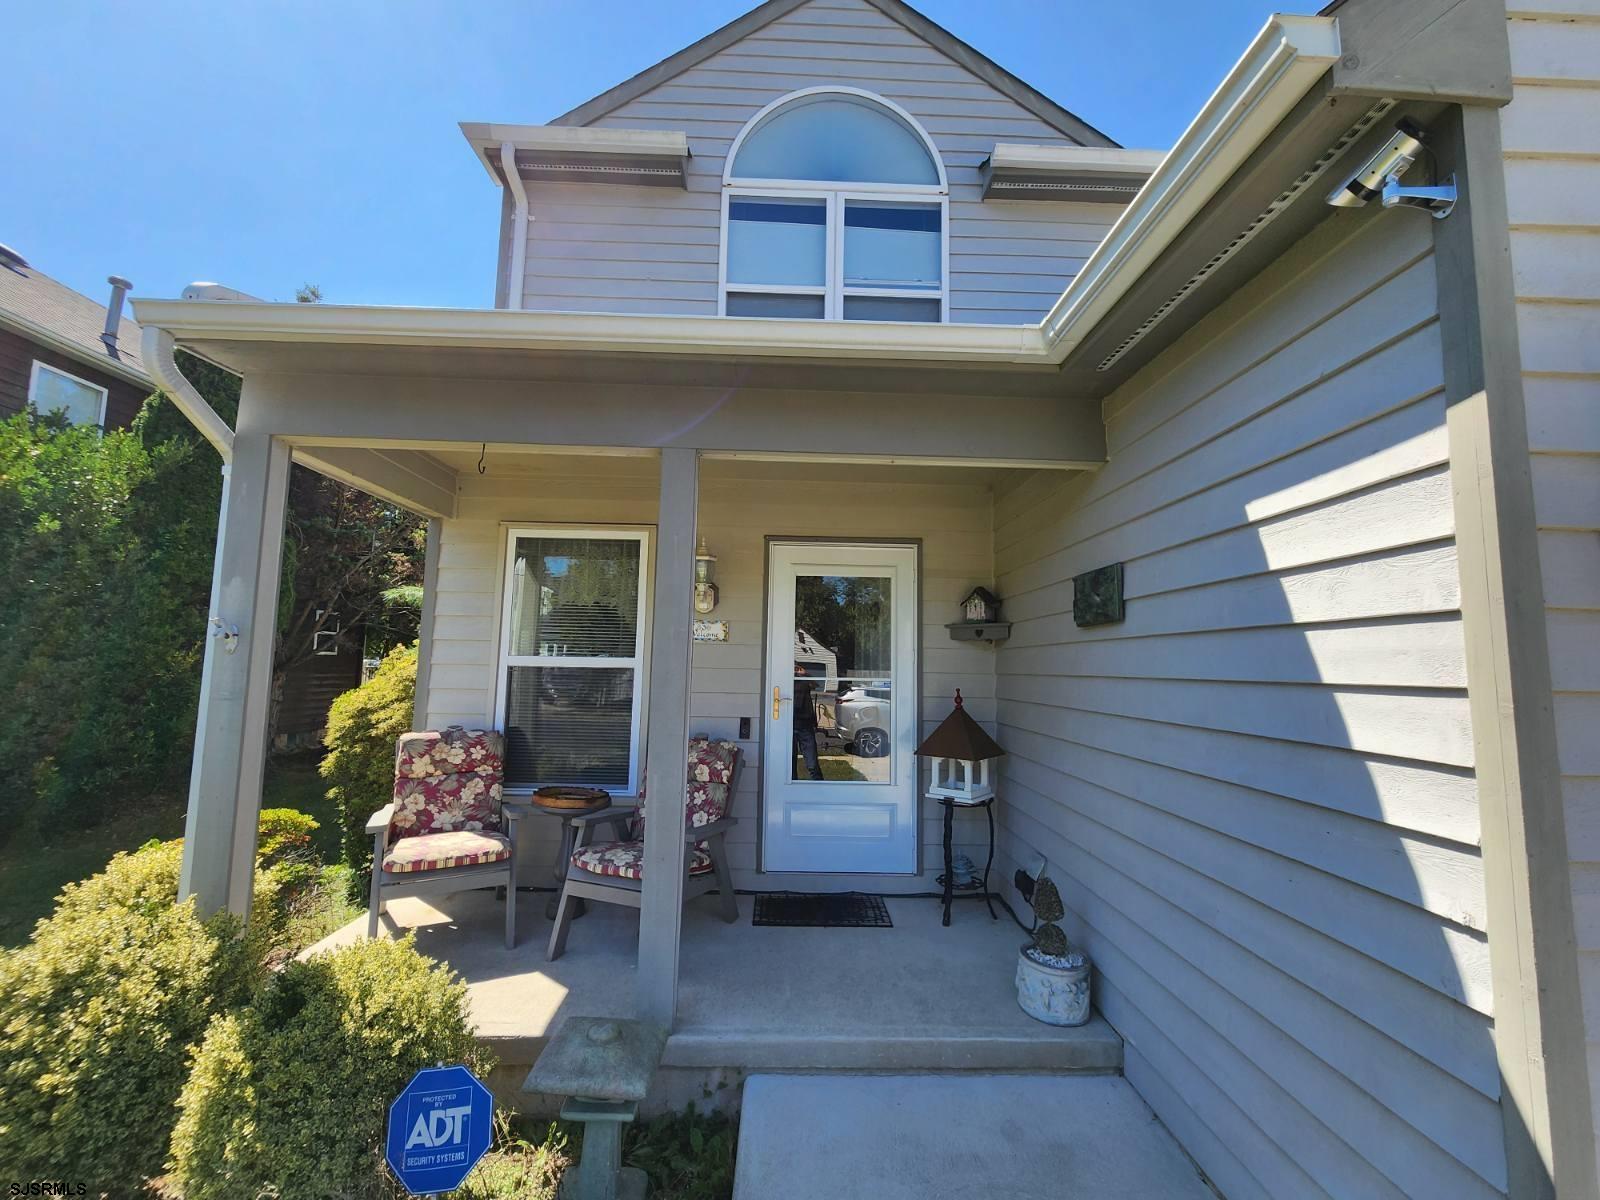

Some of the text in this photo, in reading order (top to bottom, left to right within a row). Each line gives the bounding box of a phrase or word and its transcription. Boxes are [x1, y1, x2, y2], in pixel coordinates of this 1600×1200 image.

[422, 1094, 457, 1103] PROTECTED
[405, 1106, 472, 1150] ADT
[407, 1152, 465, 1167] SECURITY SYSTEMS
